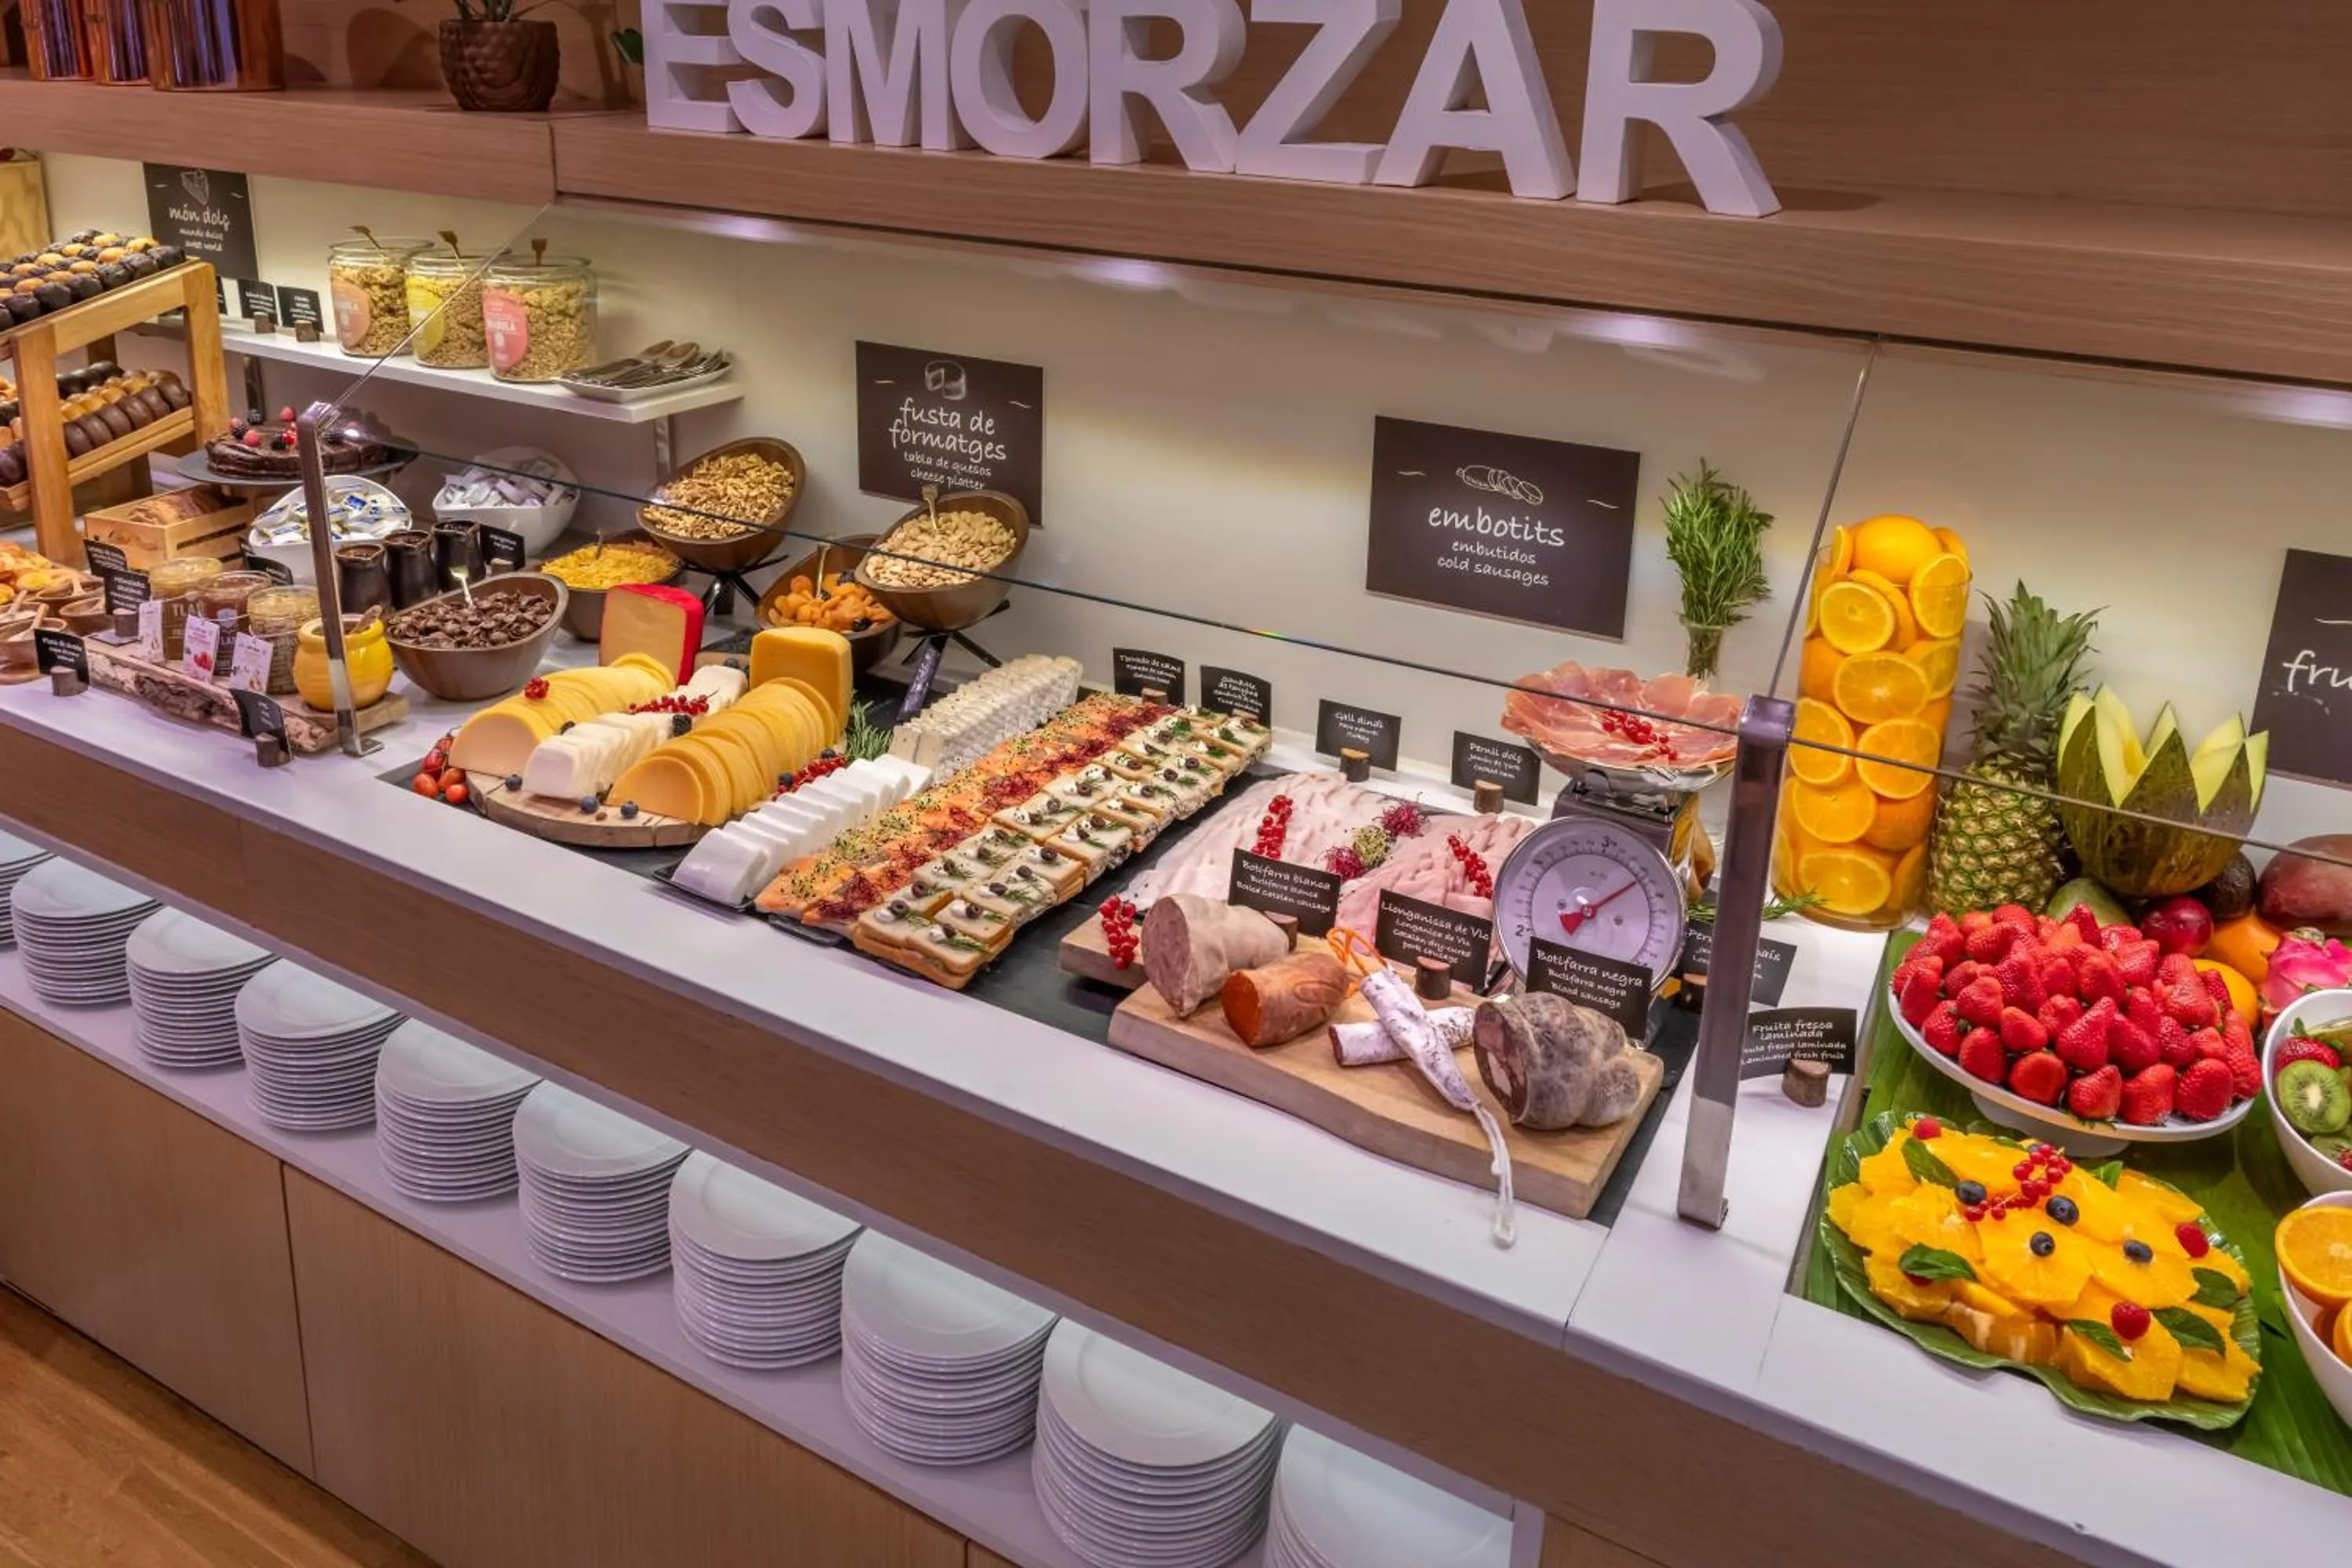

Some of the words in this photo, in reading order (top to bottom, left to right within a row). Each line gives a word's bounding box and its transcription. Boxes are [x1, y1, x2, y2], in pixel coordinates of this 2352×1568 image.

[643, 0, 1784, 220] ESMORZAR
[900, 397, 961, 427] fusta
[970, 411, 995, 435] de
[888, 419, 1007, 463] formatges
[904, 451, 933, 466] tabla
[935, 456, 949, 469] de
[952, 461, 992, 477] quesos
[910, 468, 945, 483] cheese
[947, 474, 985, 490] platter
[1428, 506, 1565, 547] embotits
[1451, 539, 1537, 564] embutidos
[1437, 555, 1469, 571] cold
[1474, 562, 1549, 586] sausages
[1444, 933, 1455, 942] de
[1454, 924, 1468, 935] de
[1537, 949, 1597, 975] Botifarra
[1602, 971, 1643, 987] negra
[1597, 984, 1627, 997] negra
[1753, 1022, 1791, 1034] Fruita
[1795, 1018, 1833, 1033] fresca
